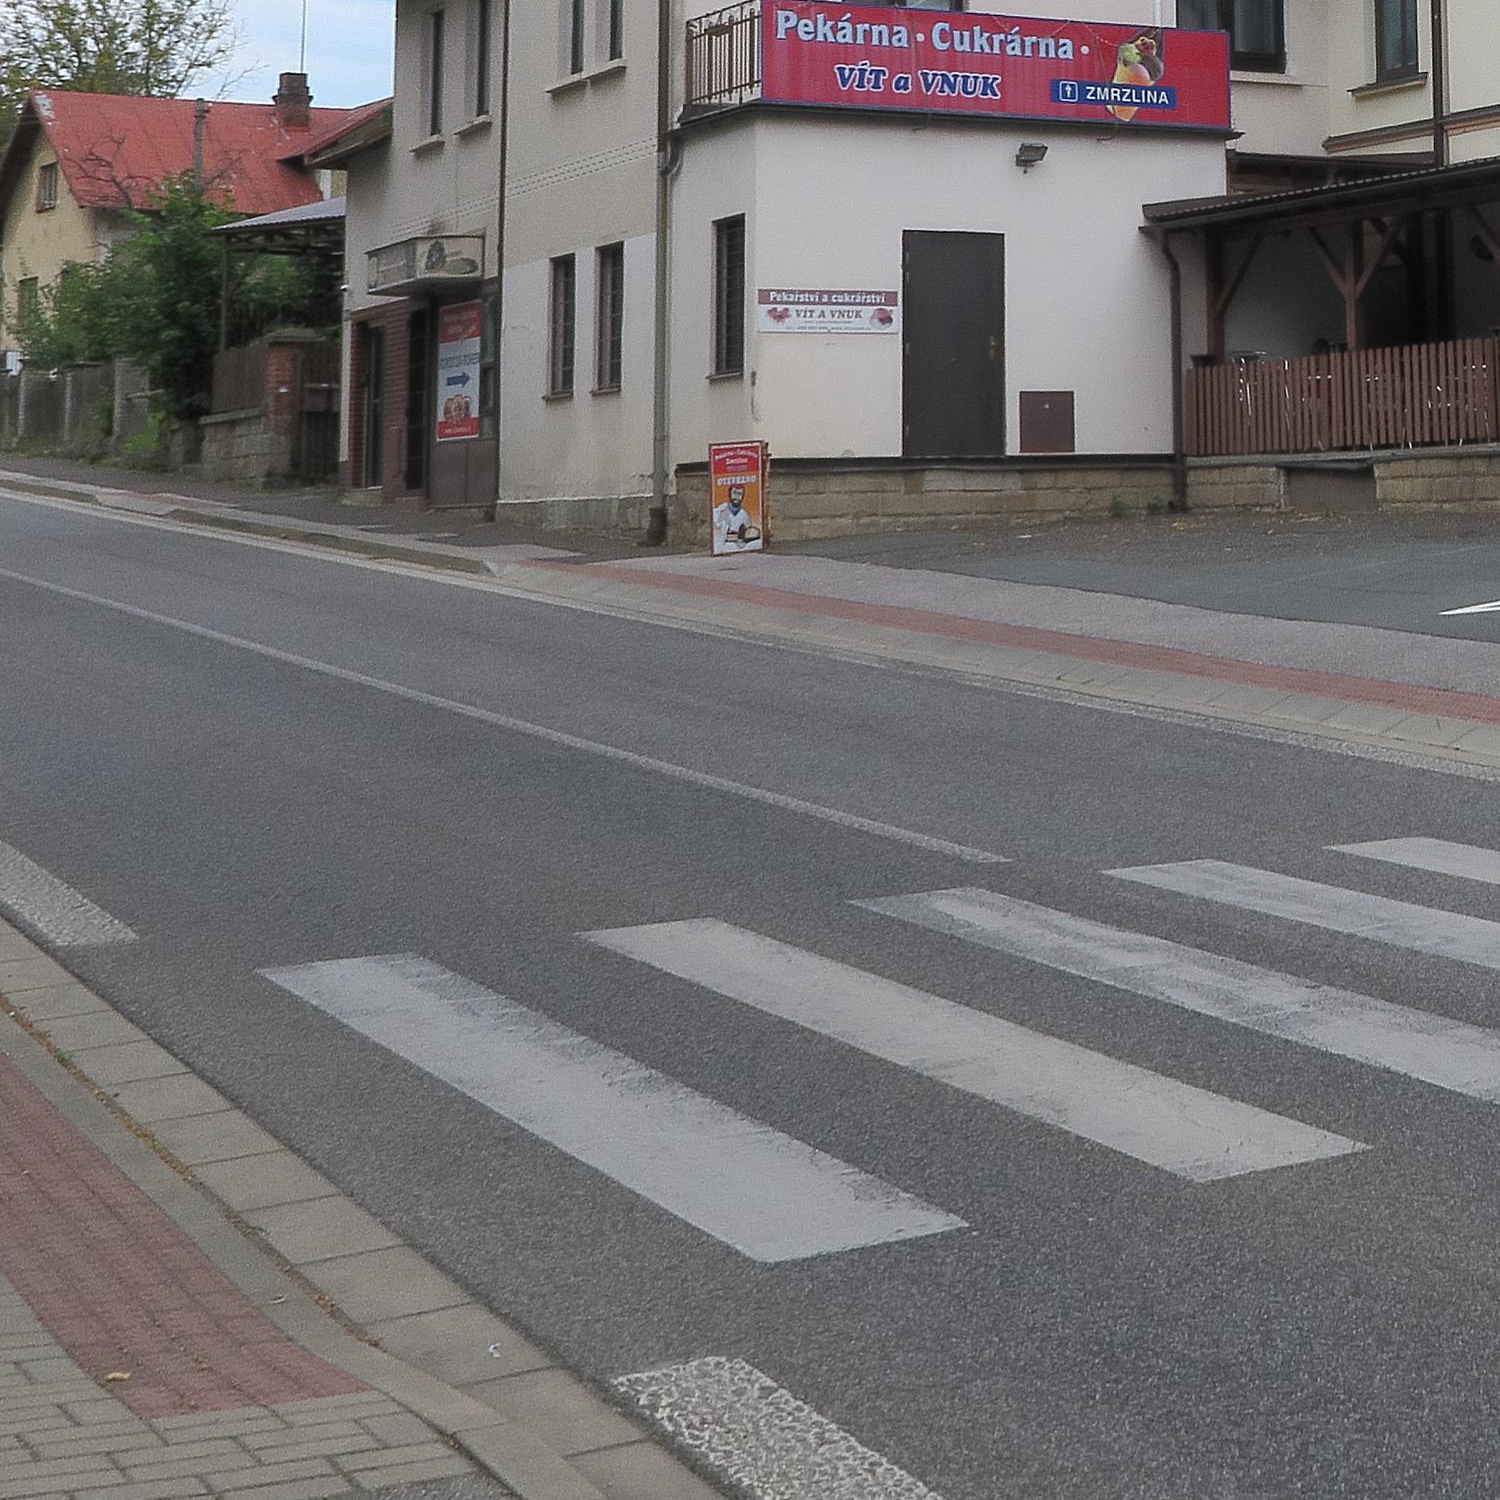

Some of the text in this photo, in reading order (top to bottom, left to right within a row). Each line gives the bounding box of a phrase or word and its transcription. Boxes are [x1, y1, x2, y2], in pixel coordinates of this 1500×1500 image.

[776, 9, 1074, 60] Pekárna Cukrárna
[835, 60, 1001, 98] VÍT a VNUK
[1086, 86, 1169, 105] ZMRZLINA
[829, 309, 863, 319] VNUK
